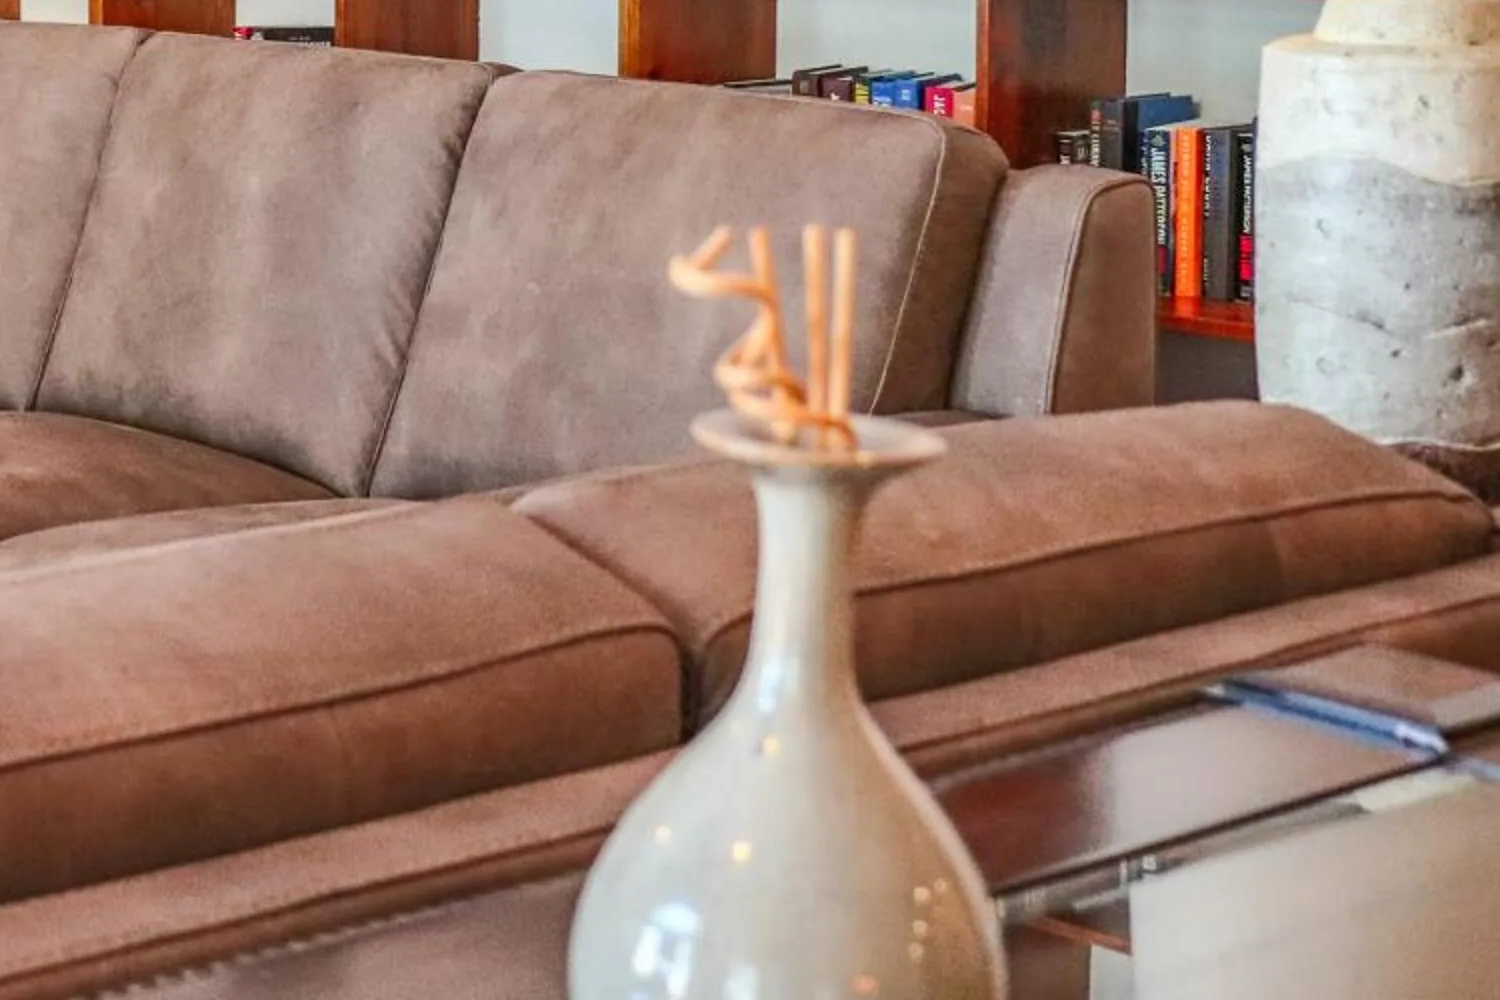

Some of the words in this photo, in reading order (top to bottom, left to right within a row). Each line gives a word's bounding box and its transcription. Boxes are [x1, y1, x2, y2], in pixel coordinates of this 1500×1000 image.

[1151, 147, 1168, 183] JAMES
[1243, 155, 1252, 184] JAMES
[1243, 185, 1253, 235] PATTERSON
